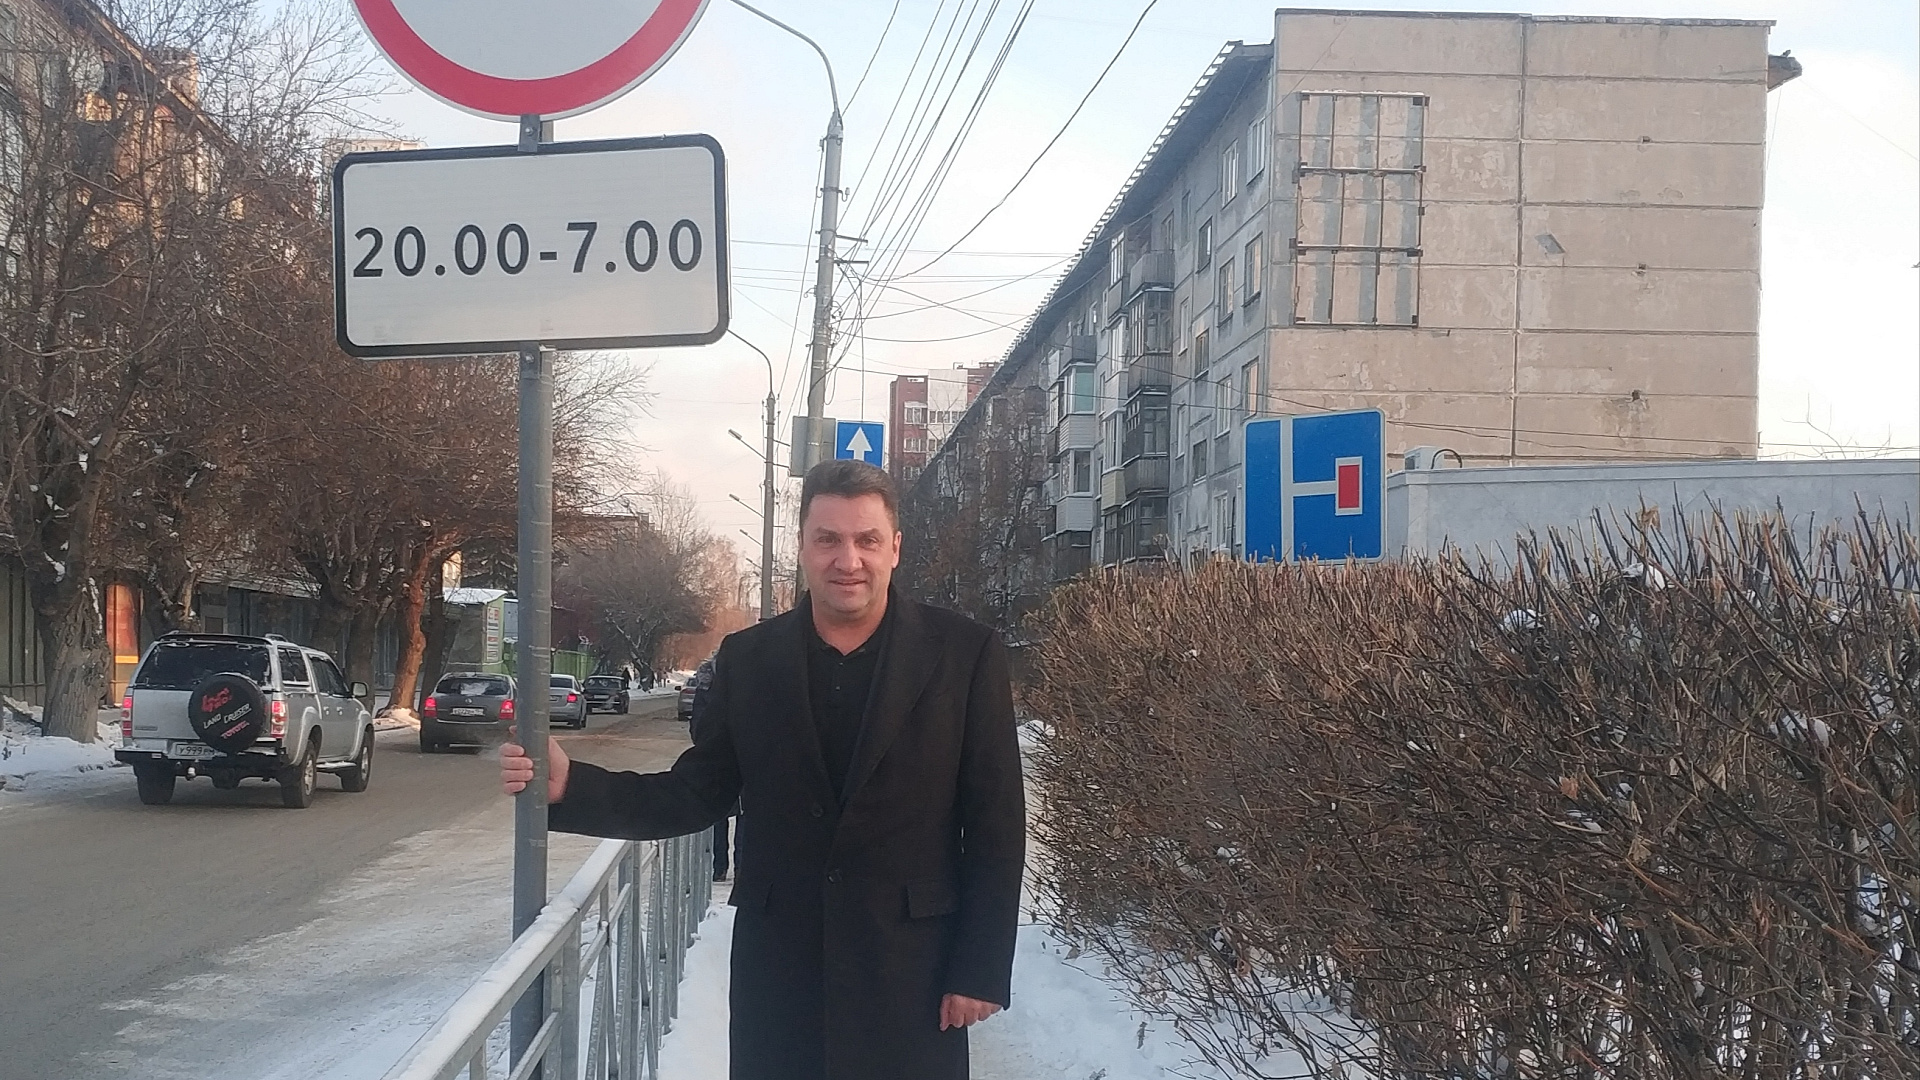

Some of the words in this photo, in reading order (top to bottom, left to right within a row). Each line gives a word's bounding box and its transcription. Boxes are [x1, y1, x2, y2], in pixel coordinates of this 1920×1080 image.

[353, 218, 703, 278] 20.00-7.00
[203, 713, 221, 729] LAND
[223, 703, 252, 723] CRUISER
[221, 720, 249, 739] TOYOTA
